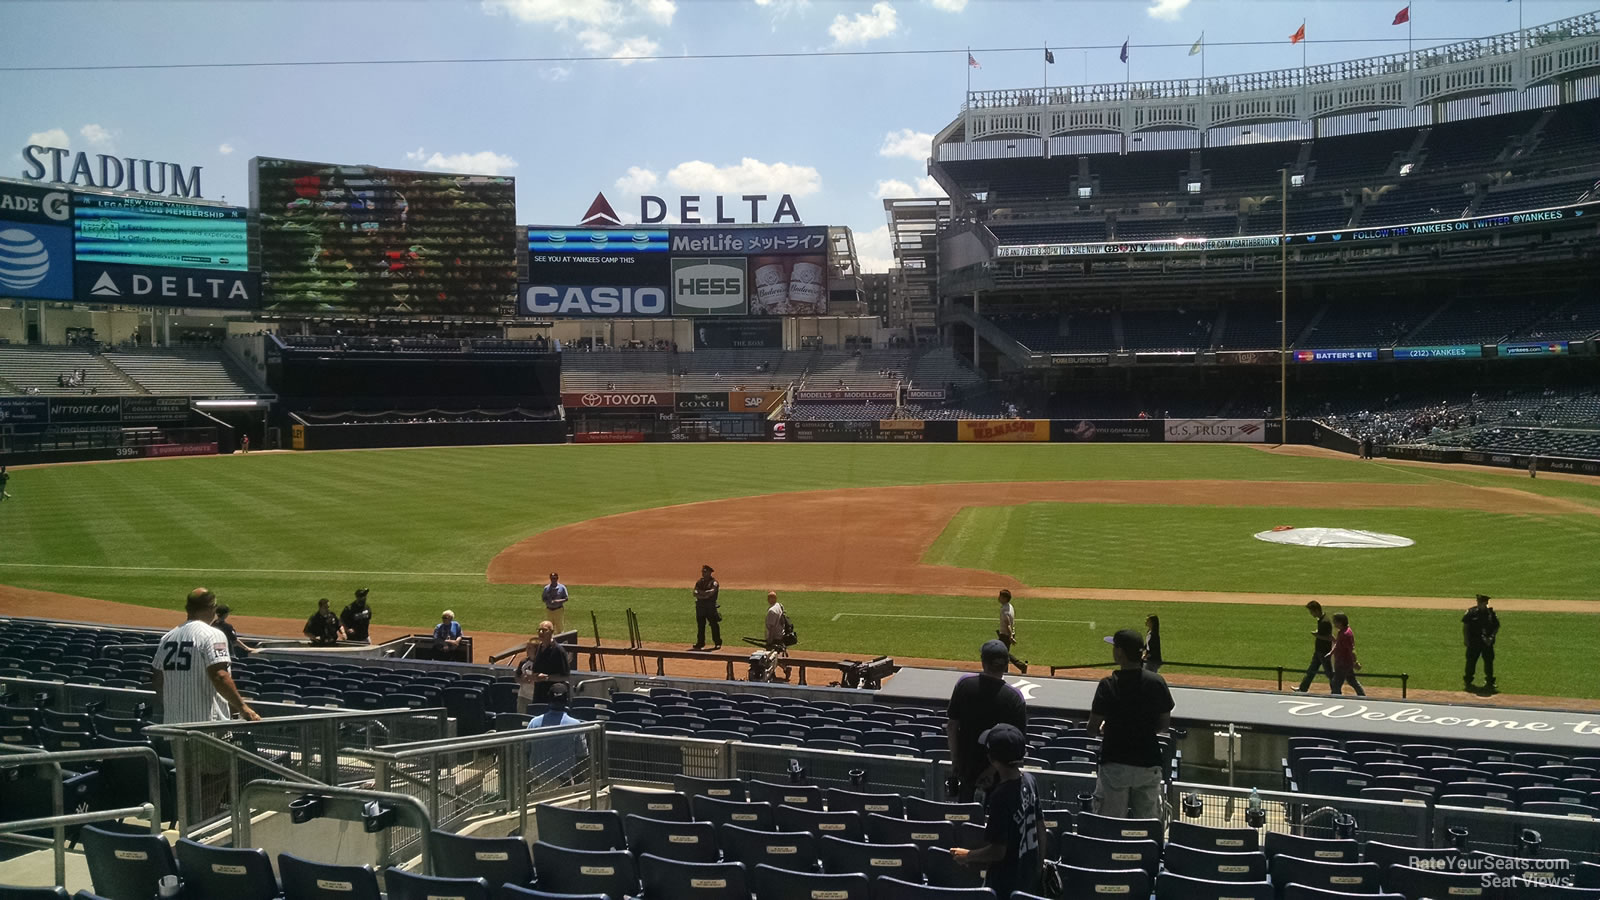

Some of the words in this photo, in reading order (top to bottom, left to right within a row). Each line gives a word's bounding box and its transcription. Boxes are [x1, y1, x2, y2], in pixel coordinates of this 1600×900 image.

[22, 144, 204, 199] STADIUM
[165, 207, 225, 218] MEMBERSHIP
[641, 194, 802, 223] DELTA
[1353, 229, 1390, 240] FOLLOW
[1391, 227, 1409, 237] THE
[1411, 224, 1453, 235] YANKEES
[1455, 222, 1469, 231] ON
[1472, 217, 1510, 229] TWITTER
[1512, 211, 1563, 224] @YANKEES
[673, 234, 743, 251] MetLife
[749, 234, 825, 249] メットライフ
[1063, 246, 1071, 255] ON
[601, 256, 619, 264] CAMP
[133, 275, 249, 300] DELTA
[678, 278, 741, 296] HESS
[526, 286, 665, 313] CASIO
[603, 394, 657, 405] TOYOTA
[744, 398, 763, 407] SAP
[51, 404, 119, 415] NITTOTIRE.COM
[1169, 425, 1191, 436] U.S.
[1194, 425, 1235, 436] TRUST
[1492, 455, 1511, 463] GEICO
[163, 640, 194, 672] 25
[1278, 701, 1555, 731] Welcome
